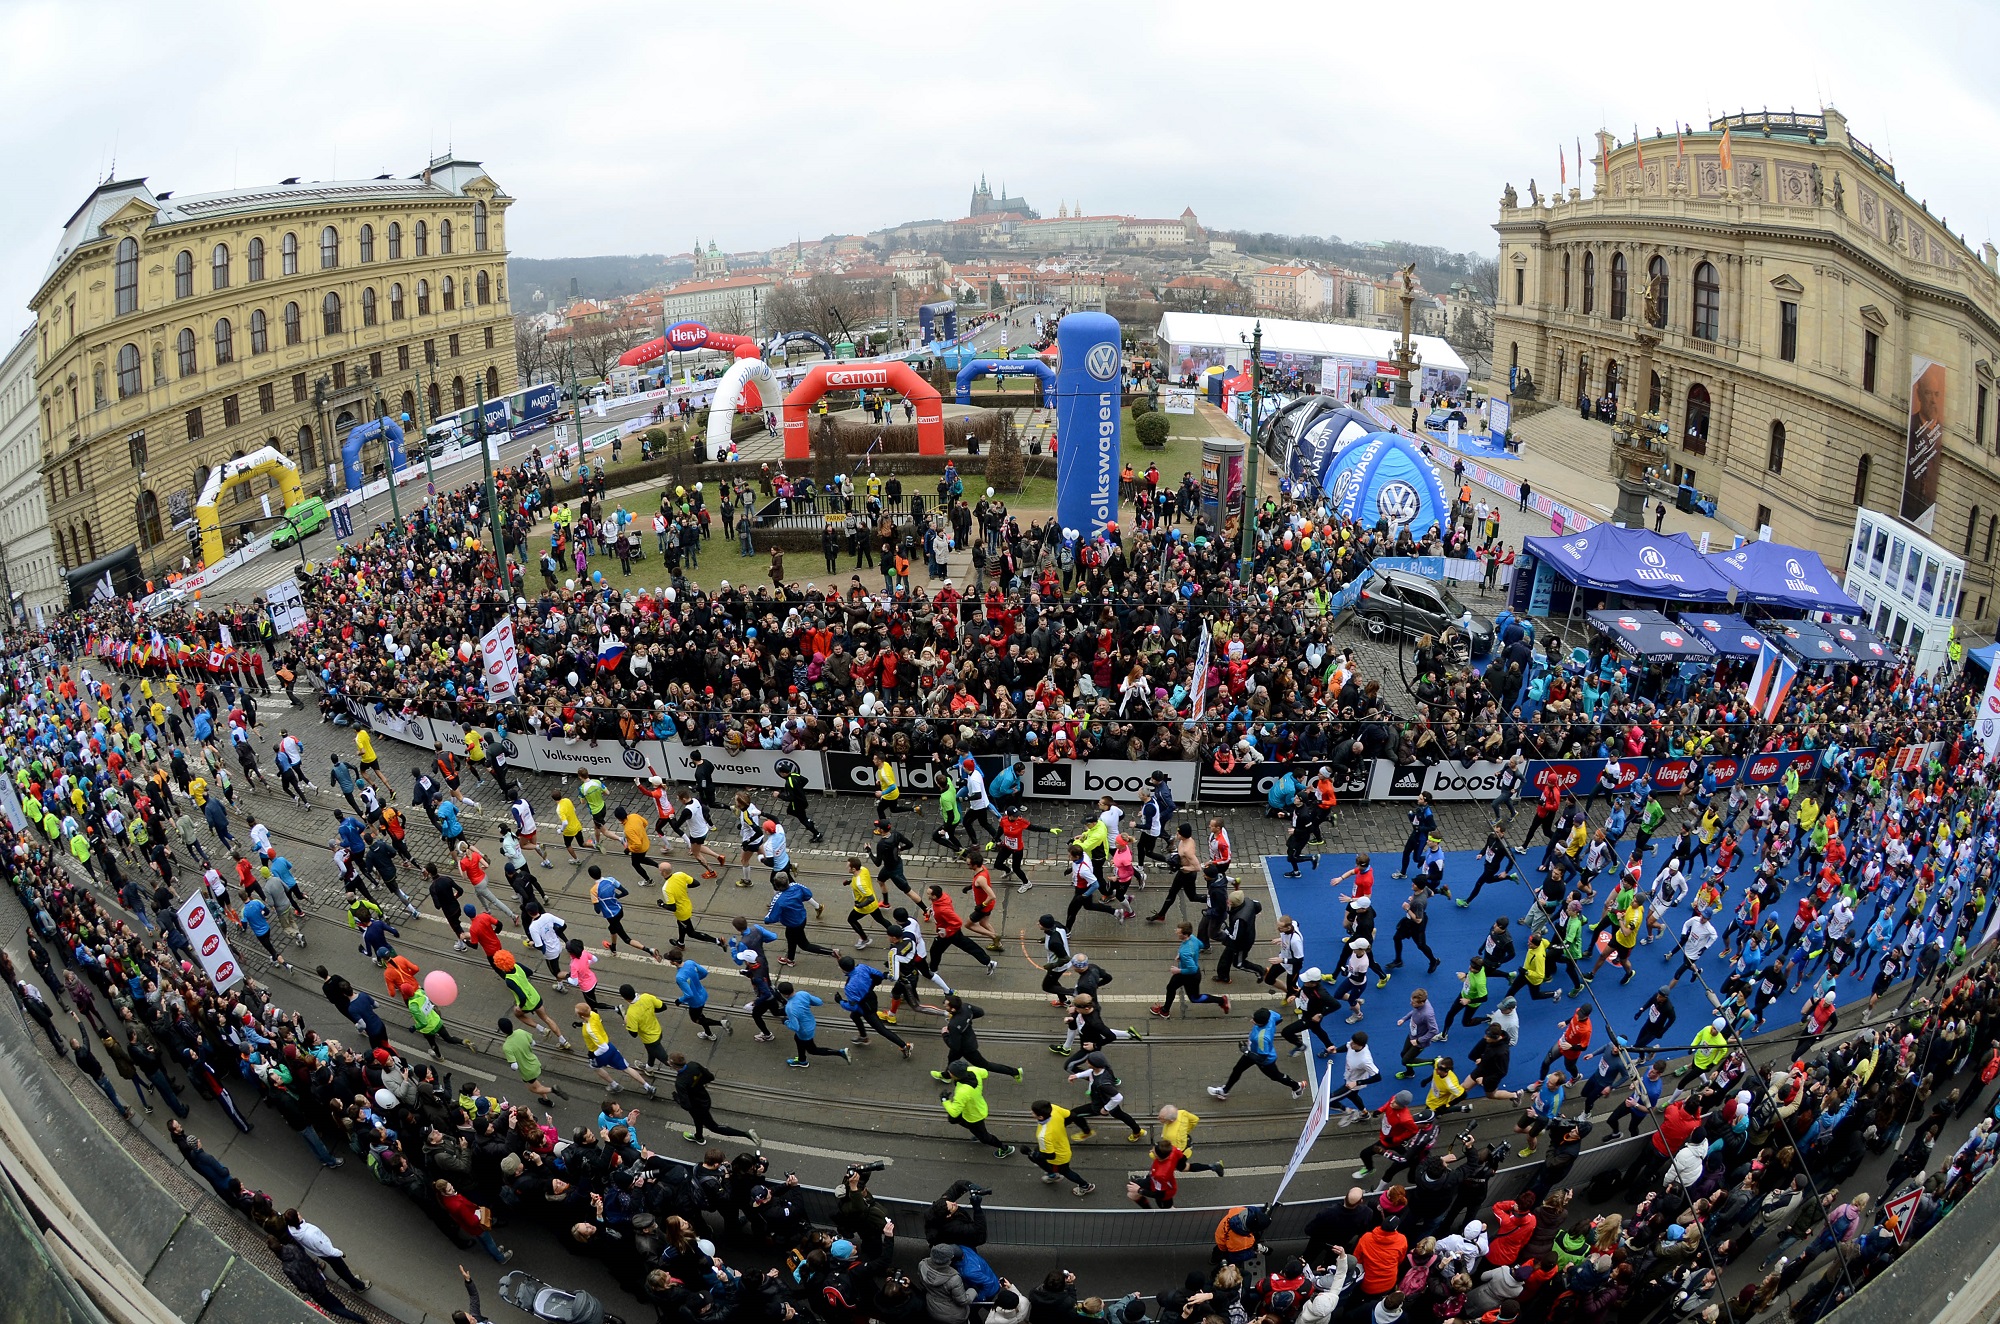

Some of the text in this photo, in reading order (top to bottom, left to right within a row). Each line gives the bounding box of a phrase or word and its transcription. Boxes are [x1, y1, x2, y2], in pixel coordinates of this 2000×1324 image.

[671, 328, 707, 342] Hervis
[827, 371, 886, 385] Canon
[646, 389, 667, 398] Canon
[484, 408, 505, 423] ATTONI
[1091, 392, 1115, 538] Volkswagen
[1341, 439, 1384, 520] OLKSWAGEN
[1562, 542, 1582, 560] Hilton
[1410, 561, 1438, 575] Blue.
[1724, 556, 1744, 571] Hilton
[185, 575, 205, 590] DNES
[1635, 568, 1686, 583] Hilton
[1784, 578, 1820, 595] Hilton
[1683, 653, 1710, 663] MATTONI
[542, 749, 612, 765] Volkswagen
[678, 756, 761, 775] Vowagen
[1657, 766, 1689, 780] Hervis
[1713, 764, 1736, 780] ervis
[1751, 762, 1778, 776] Hervis
[1037, 776, 1067, 787] adidas
[1537, 770, 1578, 787] Hrvis
[188, 908, 205, 927] Hervis
[202, 936, 219, 955] Hervis
[216, 962, 234, 981] Hervis
